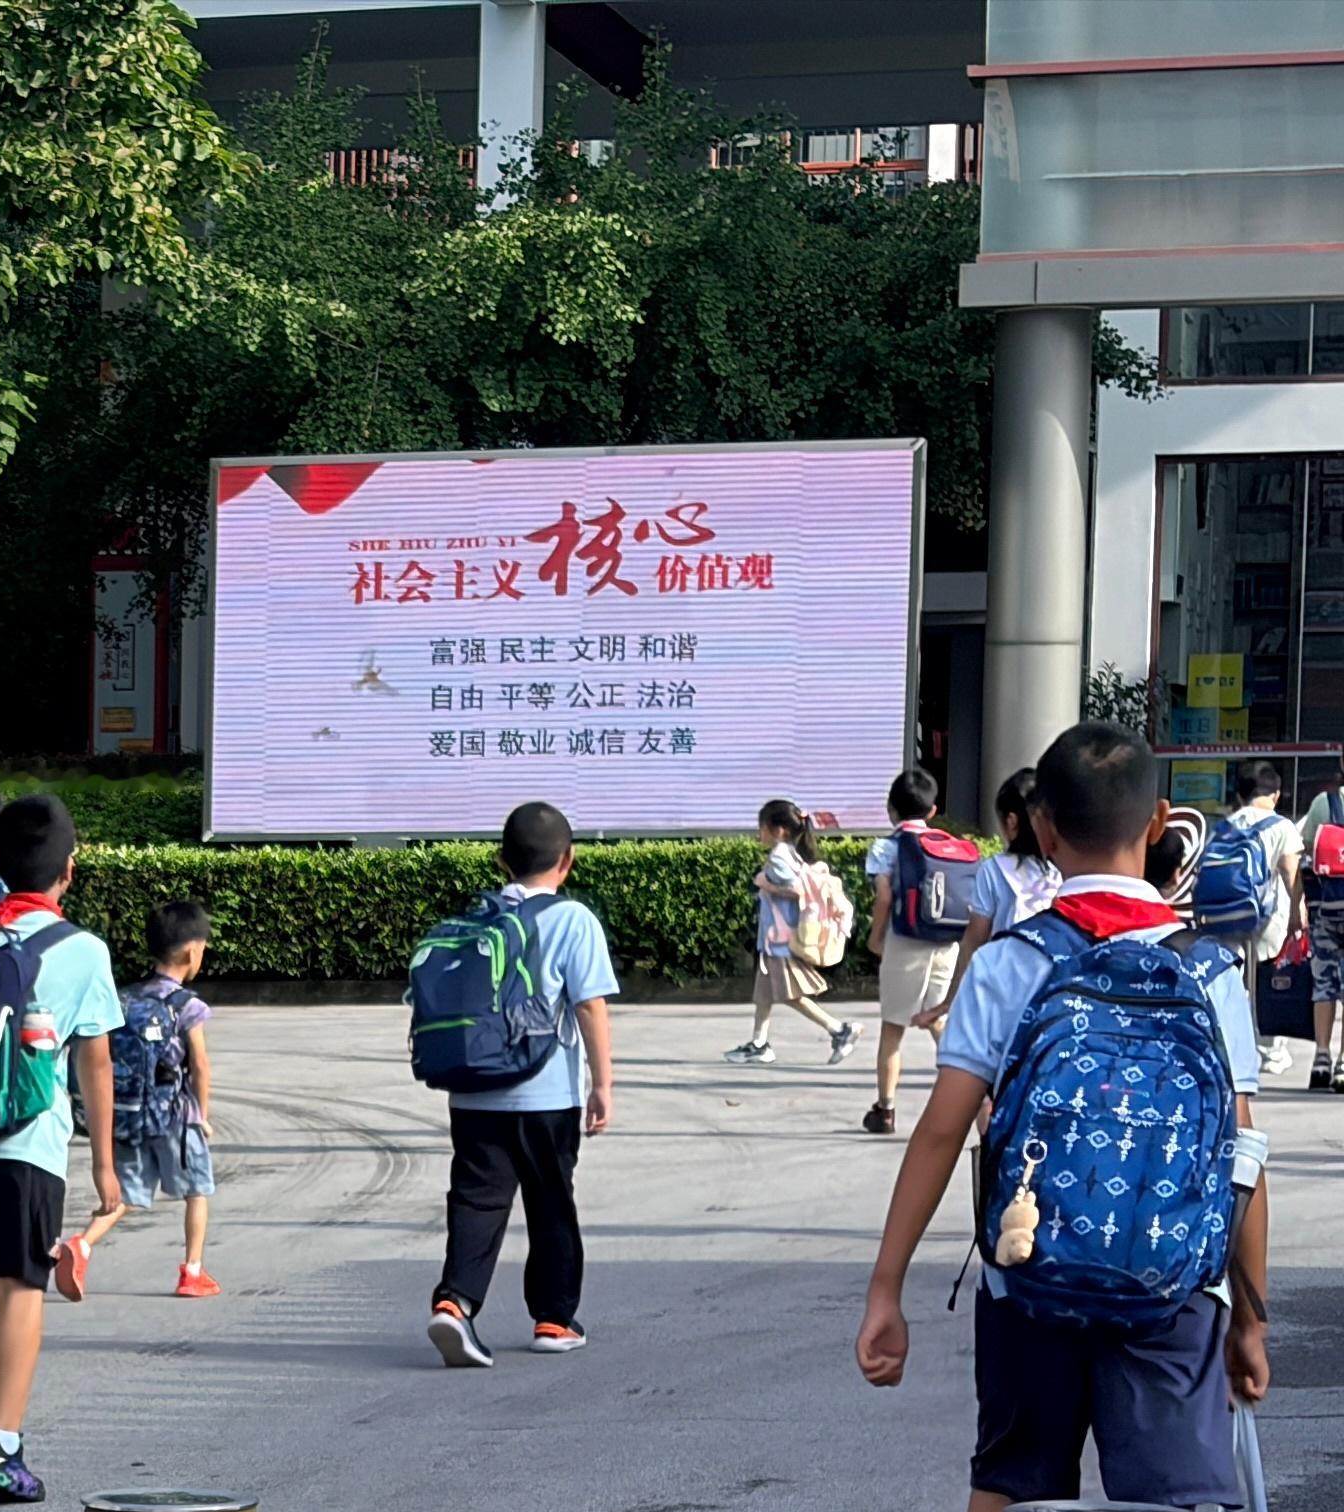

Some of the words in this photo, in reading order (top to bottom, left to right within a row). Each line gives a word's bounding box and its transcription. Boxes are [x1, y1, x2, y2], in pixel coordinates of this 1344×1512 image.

[348, 539, 390, 551] SHE
[447, 536, 487, 549] ZHU
[429, 637, 487, 665] 富强
[499, 636, 557, 664] 民主
[568, 635, 626, 663] 文明
[638, 632, 698, 663] 和谐
[430, 683, 484, 711] 自由
[497, 681, 556, 710] 平等
[565, 680, 626, 709] 公正
[637, 679, 697, 709] 法治
[429, 729, 486, 757] 爱国
[497, 728, 556, 756] 敬业
[567, 728, 626, 756] 诚信
[637, 727, 697, 755] 友善
